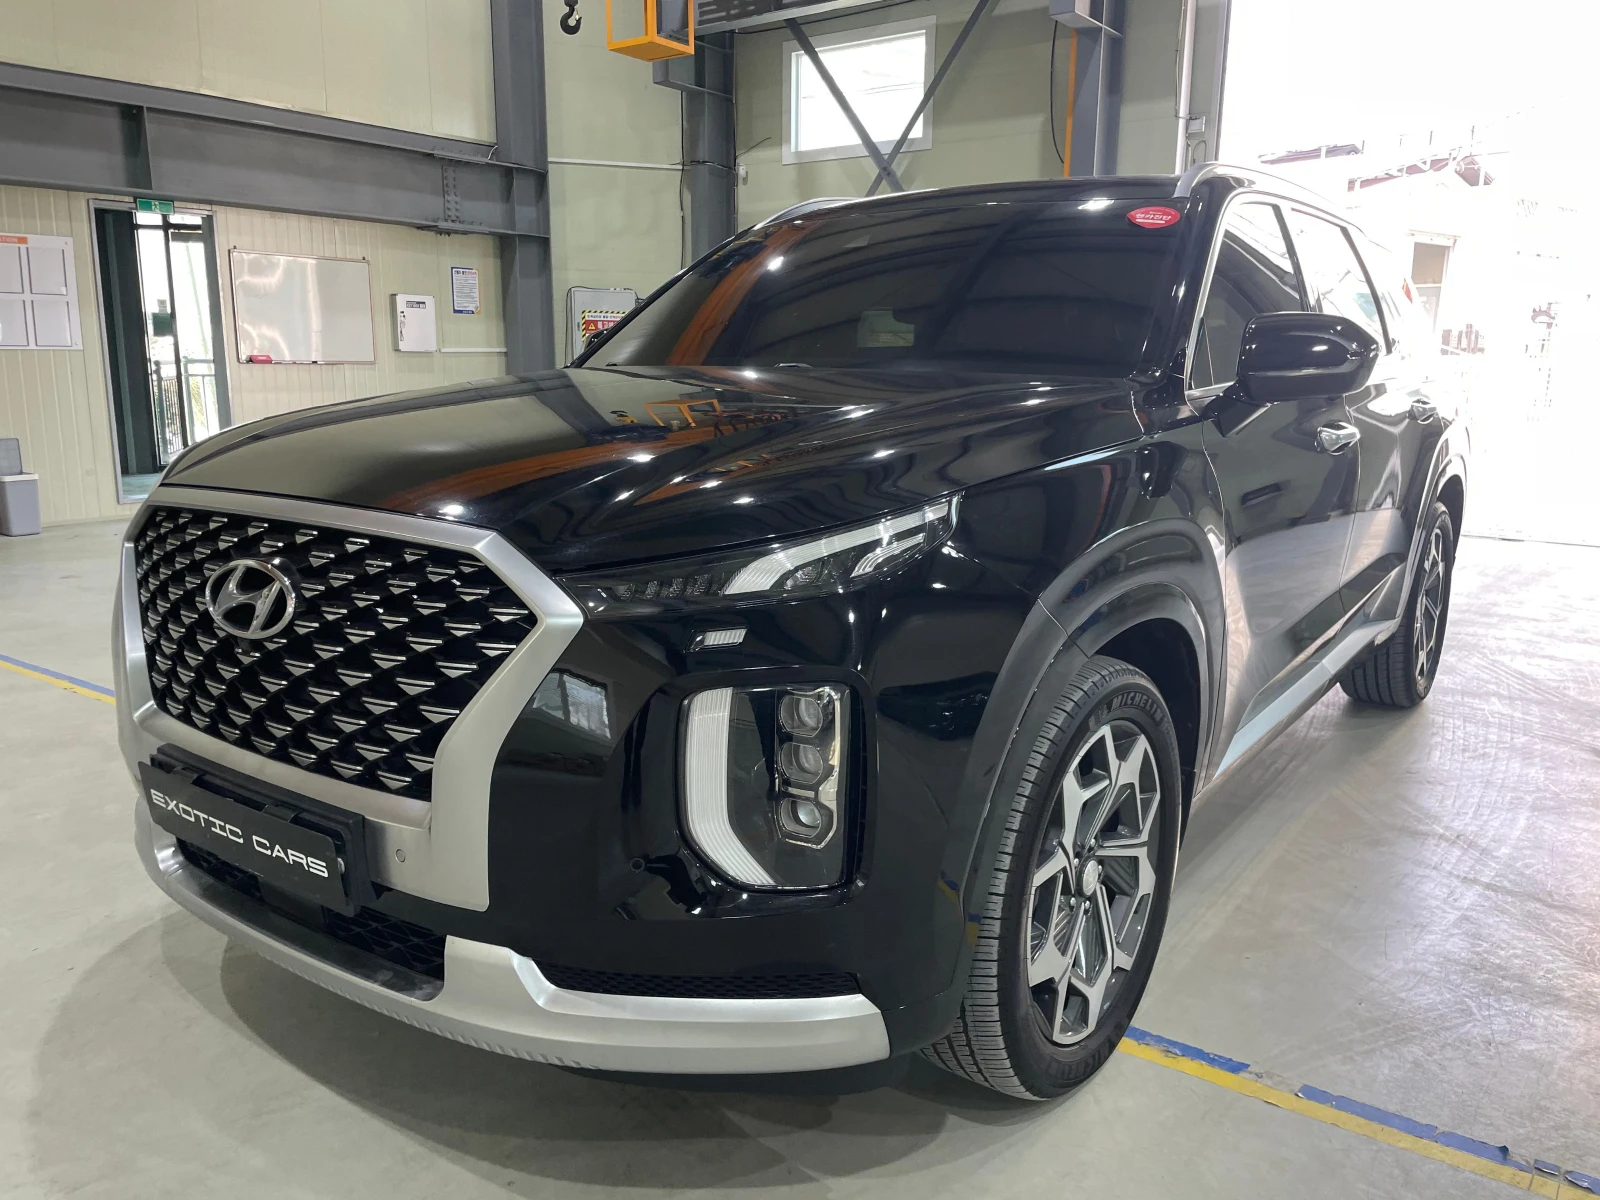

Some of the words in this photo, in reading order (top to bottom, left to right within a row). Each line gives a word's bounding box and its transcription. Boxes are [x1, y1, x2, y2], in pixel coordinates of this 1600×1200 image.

[1112, 691, 1164, 722] MICHELIN
[150, 788, 243, 843] EXOTIC
[253, 835, 329, 878] CARS
